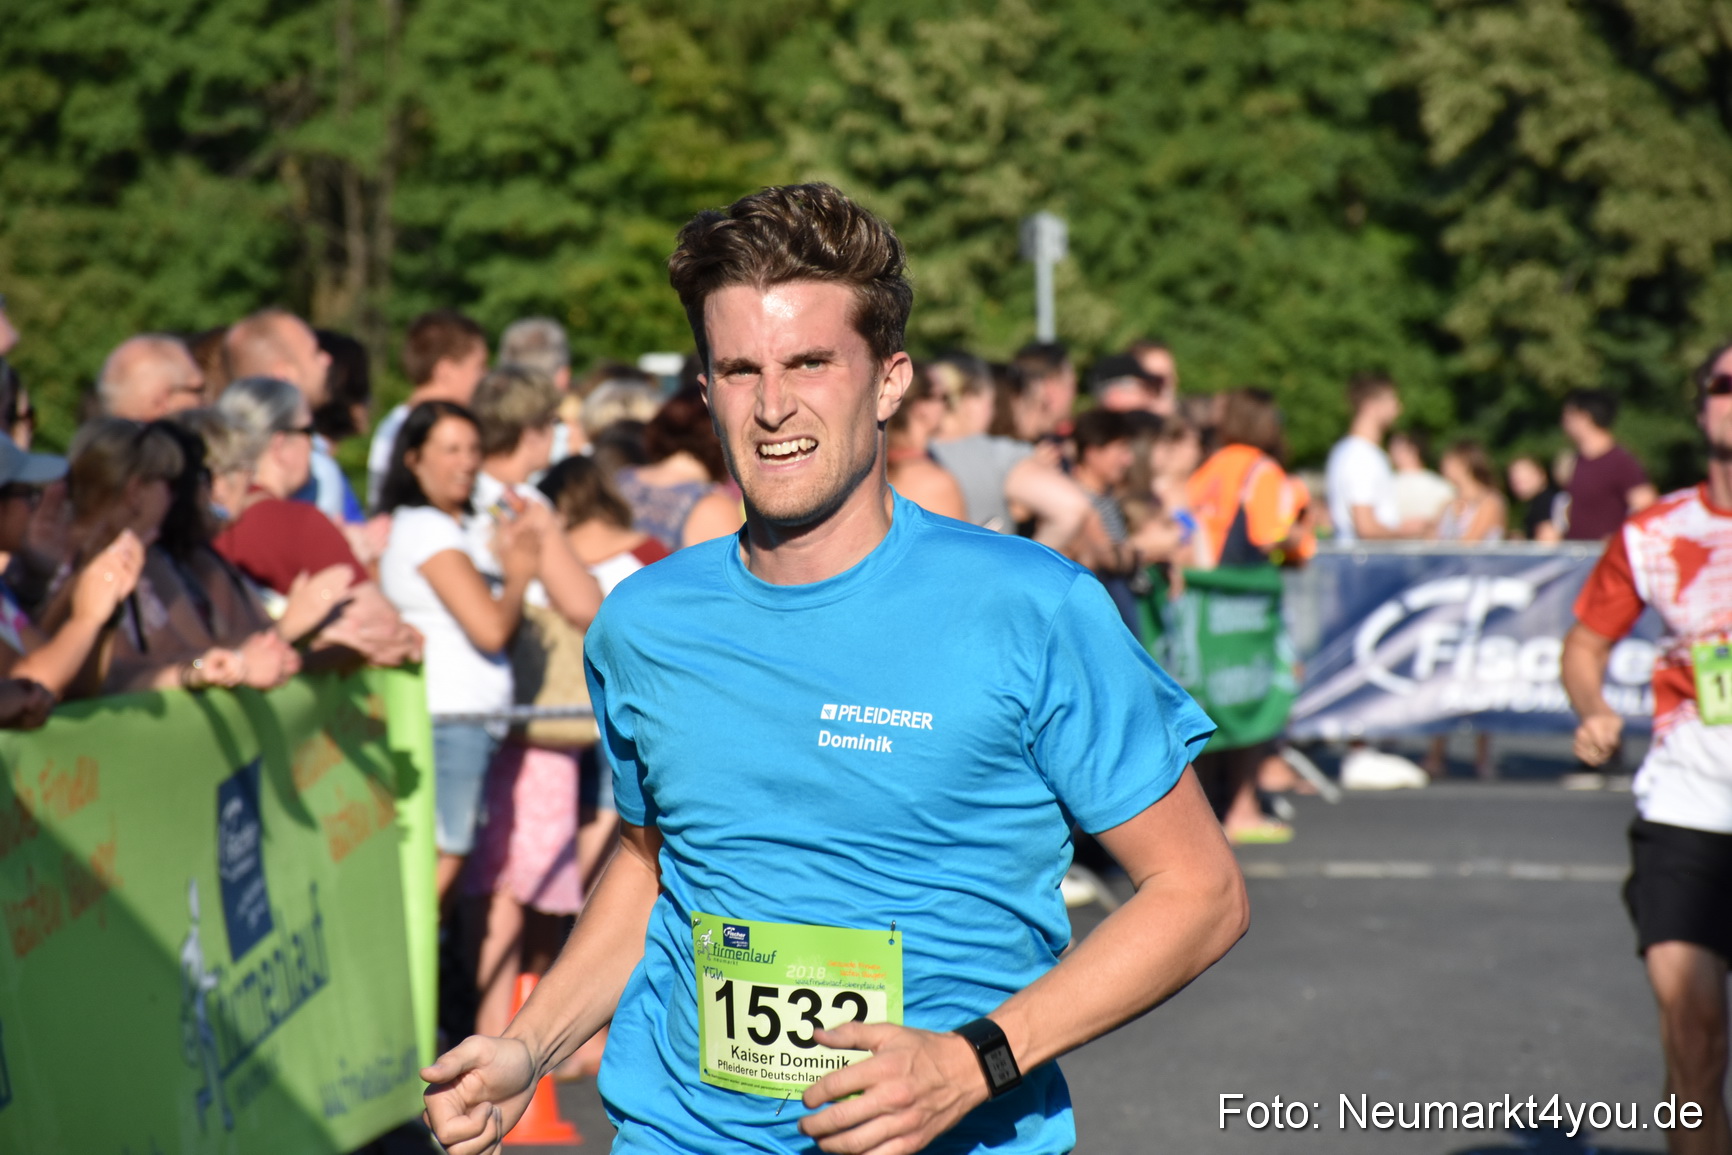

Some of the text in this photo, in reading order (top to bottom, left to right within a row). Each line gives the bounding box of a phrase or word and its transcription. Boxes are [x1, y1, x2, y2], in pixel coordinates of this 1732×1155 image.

[838, 704, 933, 730] PFLEIDERER
[818, 730, 893, 753] Dominik
[713, 943, 778, 964] firmenlauf
[786, 965, 826, 979] 2018
[715, 980, 869, 1051] 1532
[731, 1045, 850, 1069] Kaiser Dominik
[718, 1059, 758, 1078] Pfleiderer
[760, 1068, 822, 1083] Deutschlan
